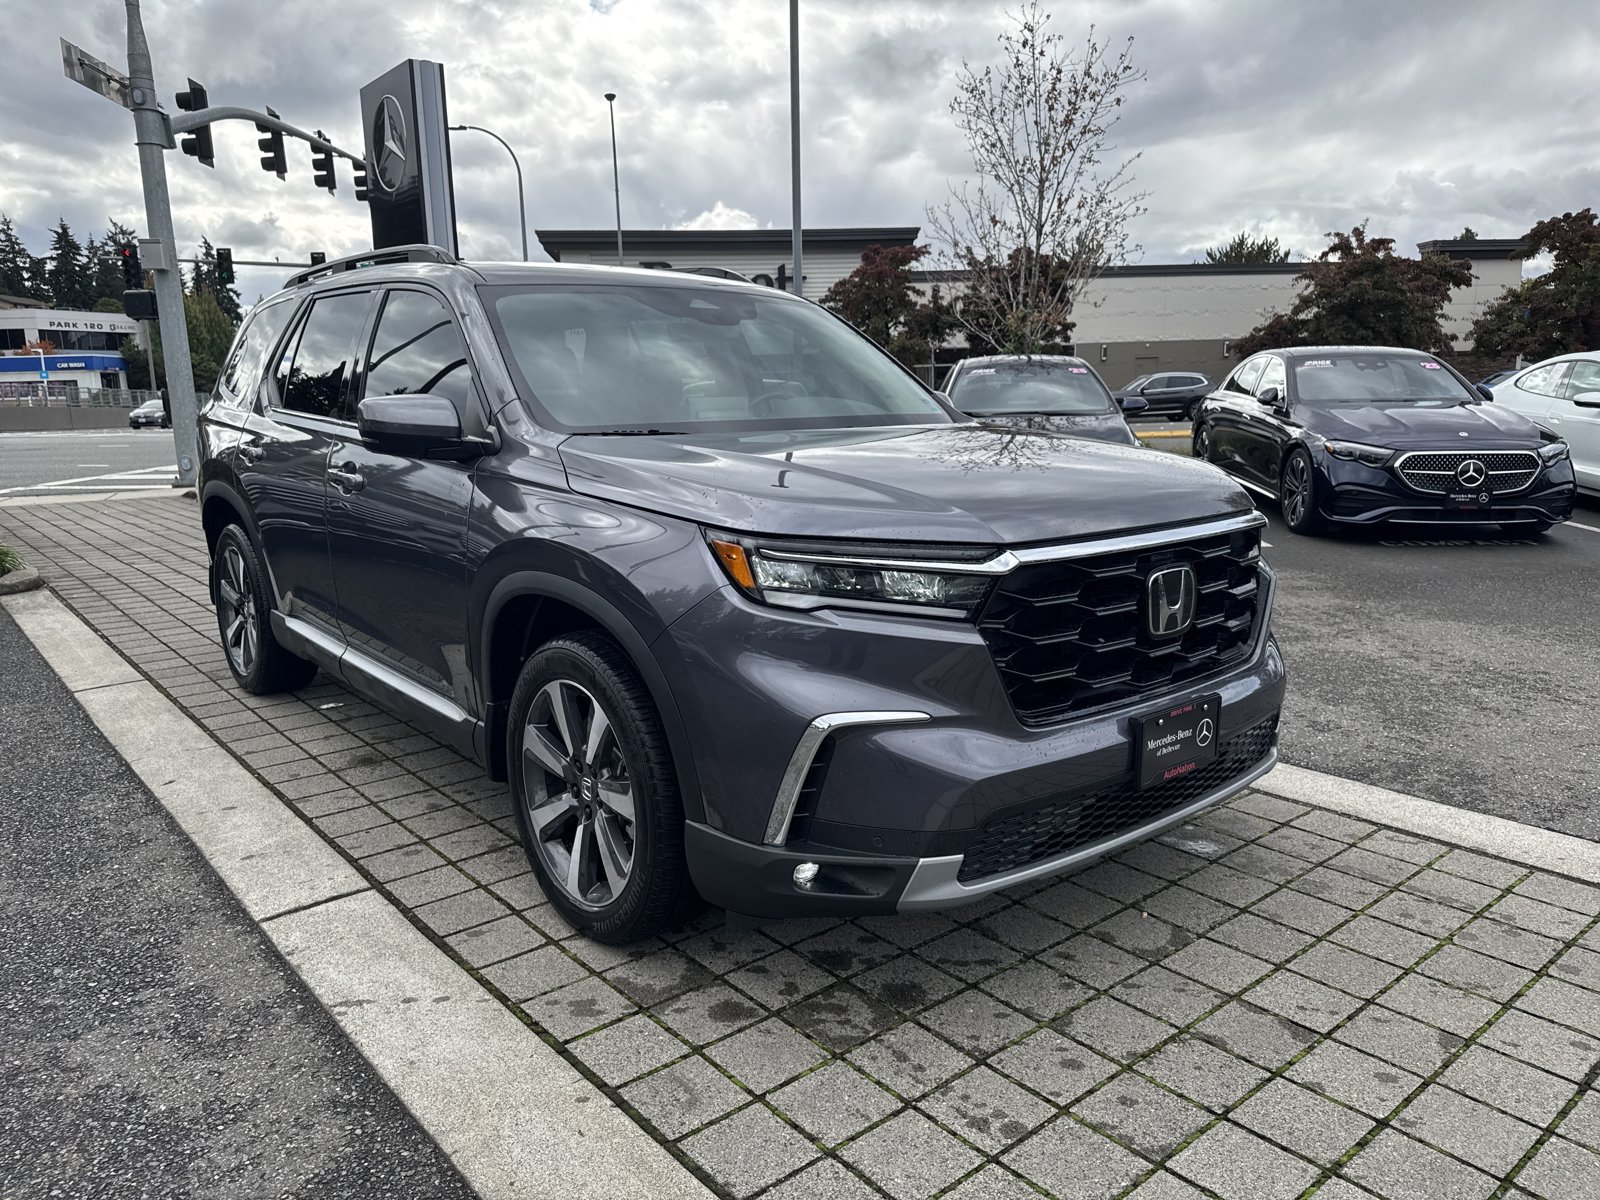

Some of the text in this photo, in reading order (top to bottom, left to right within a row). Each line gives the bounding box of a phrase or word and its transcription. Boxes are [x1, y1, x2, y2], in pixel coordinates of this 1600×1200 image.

[49, 321, 78, 329] PARK
[1147, 728, 1193, 751] Mercedes-Benz
[1162, 743, 1181, 756] Bellevue
[1163, 762, 1196, 780] AutoNation
